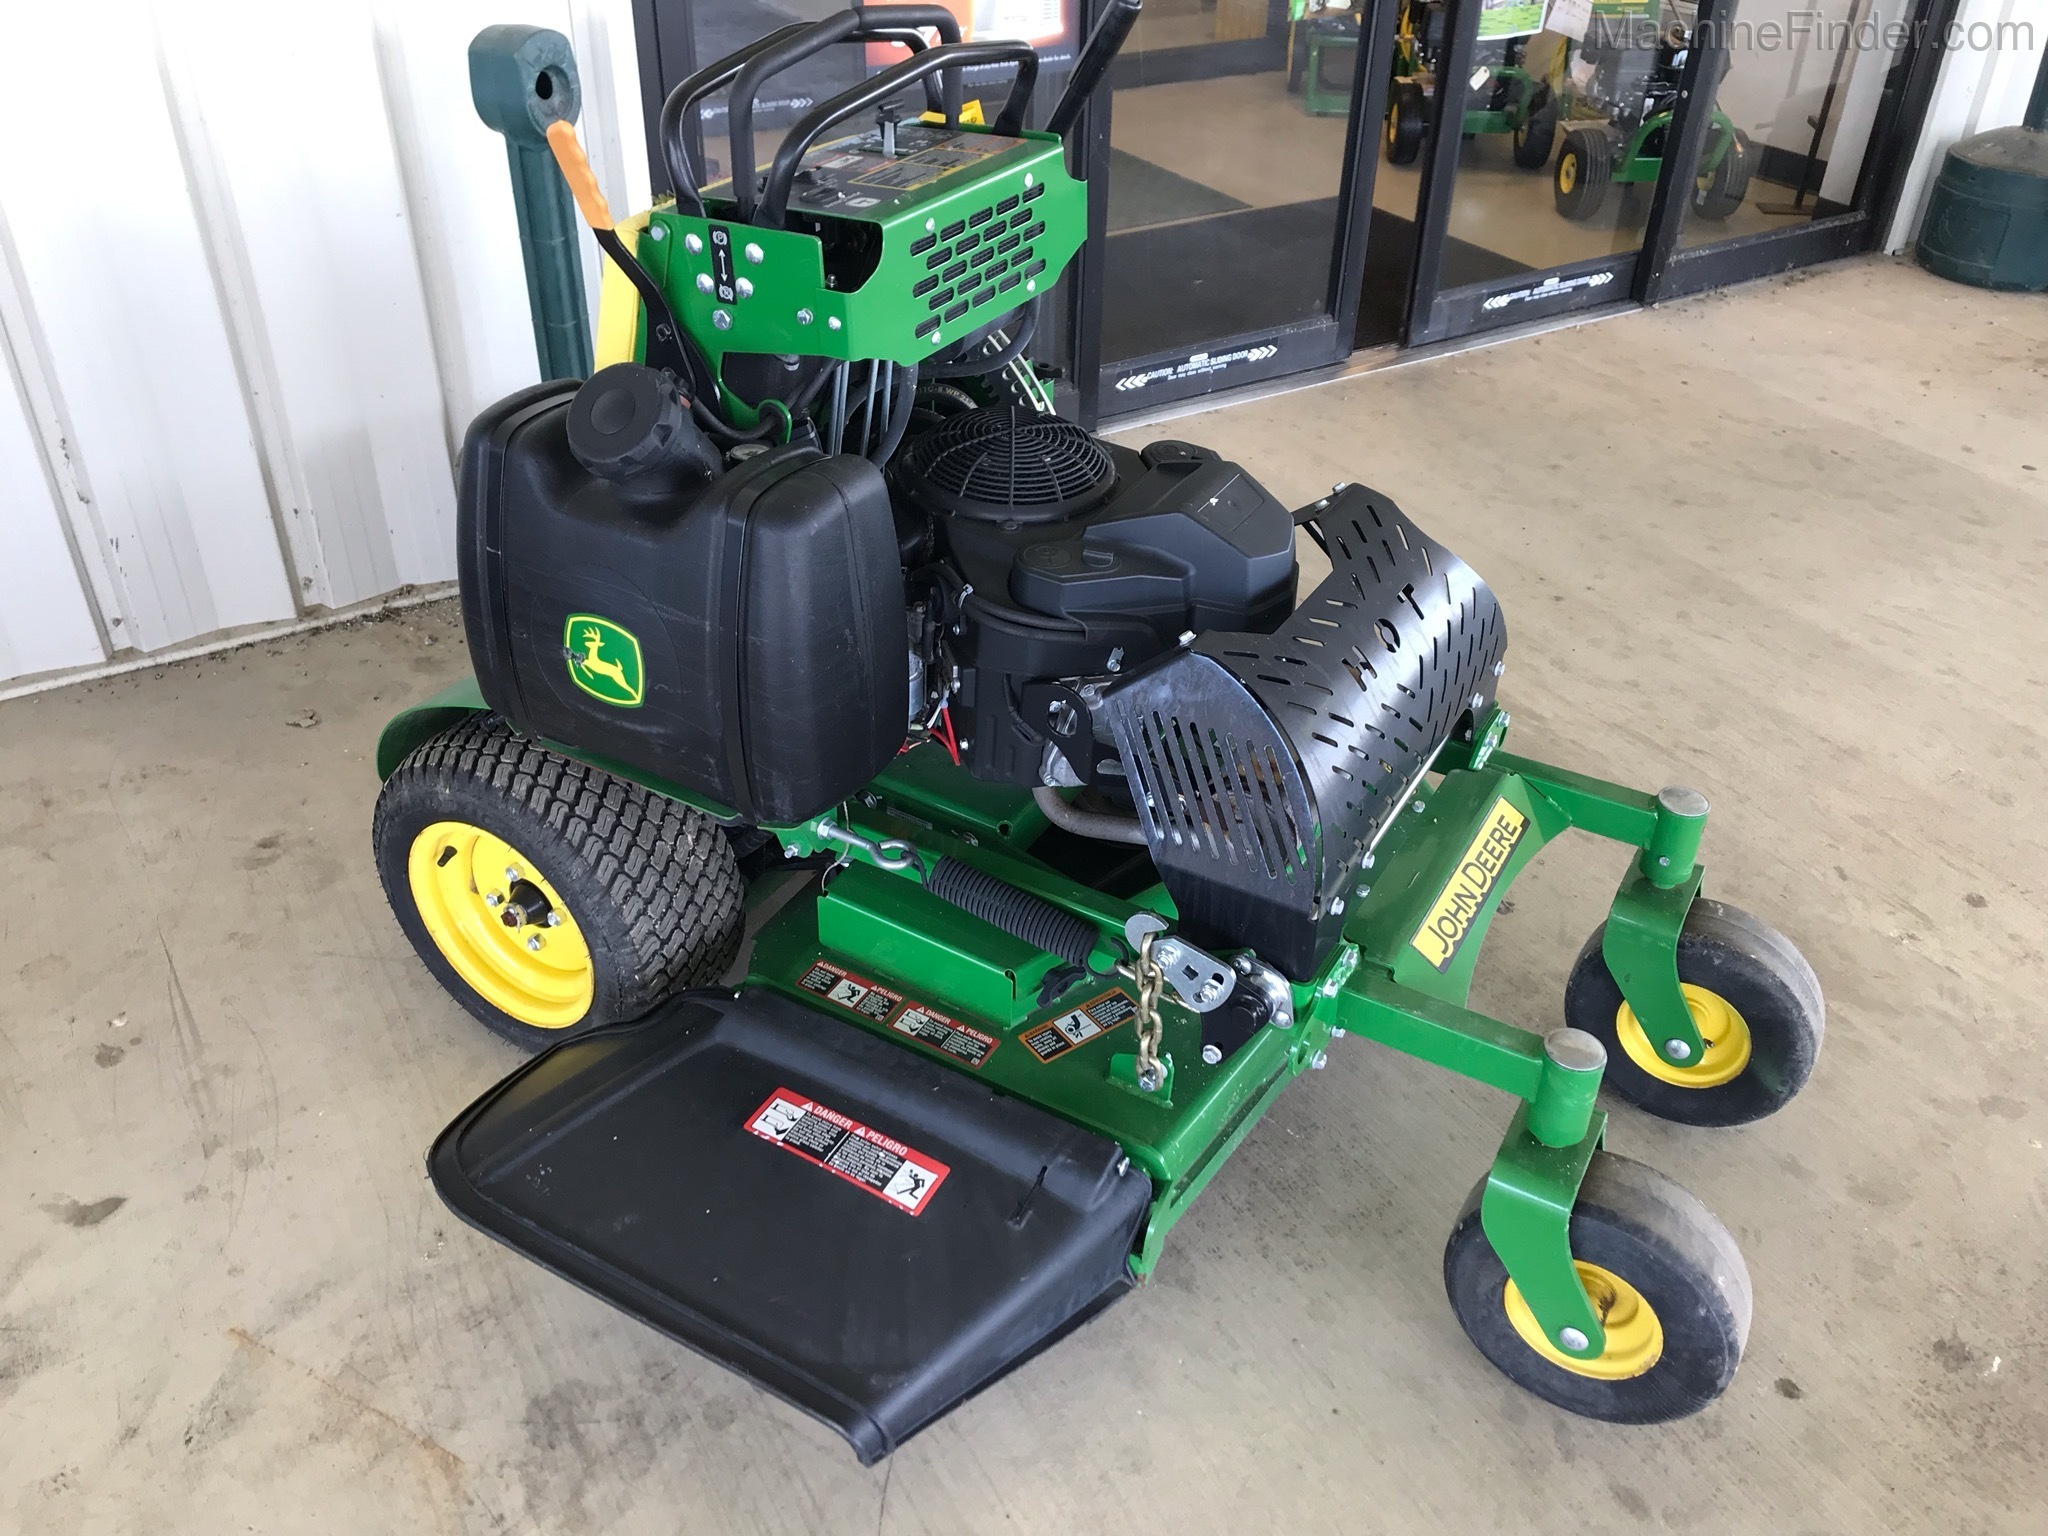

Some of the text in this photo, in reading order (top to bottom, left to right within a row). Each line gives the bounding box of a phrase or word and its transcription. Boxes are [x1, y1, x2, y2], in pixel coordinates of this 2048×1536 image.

[1177, 359, 1210, 373] AUTOMATIC
[1210, 353, 1232, 365] SLIDING
[1232, 350, 1249, 361] DOOR
[1341, 583, 1424, 692] HOT
[1427, 814, 1518, 955] JOHN DEERE
[822, 962, 848, 977] DANGER
[876, 986, 903, 1002] PELIGRO
[925, 1009, 951, 1025] DANGER
[965, 1027, 993, 1044] PELIGRO
[813, 1104, 854, 1130] DANGER
[865, 1130, 908, 1157] PELIGRO
